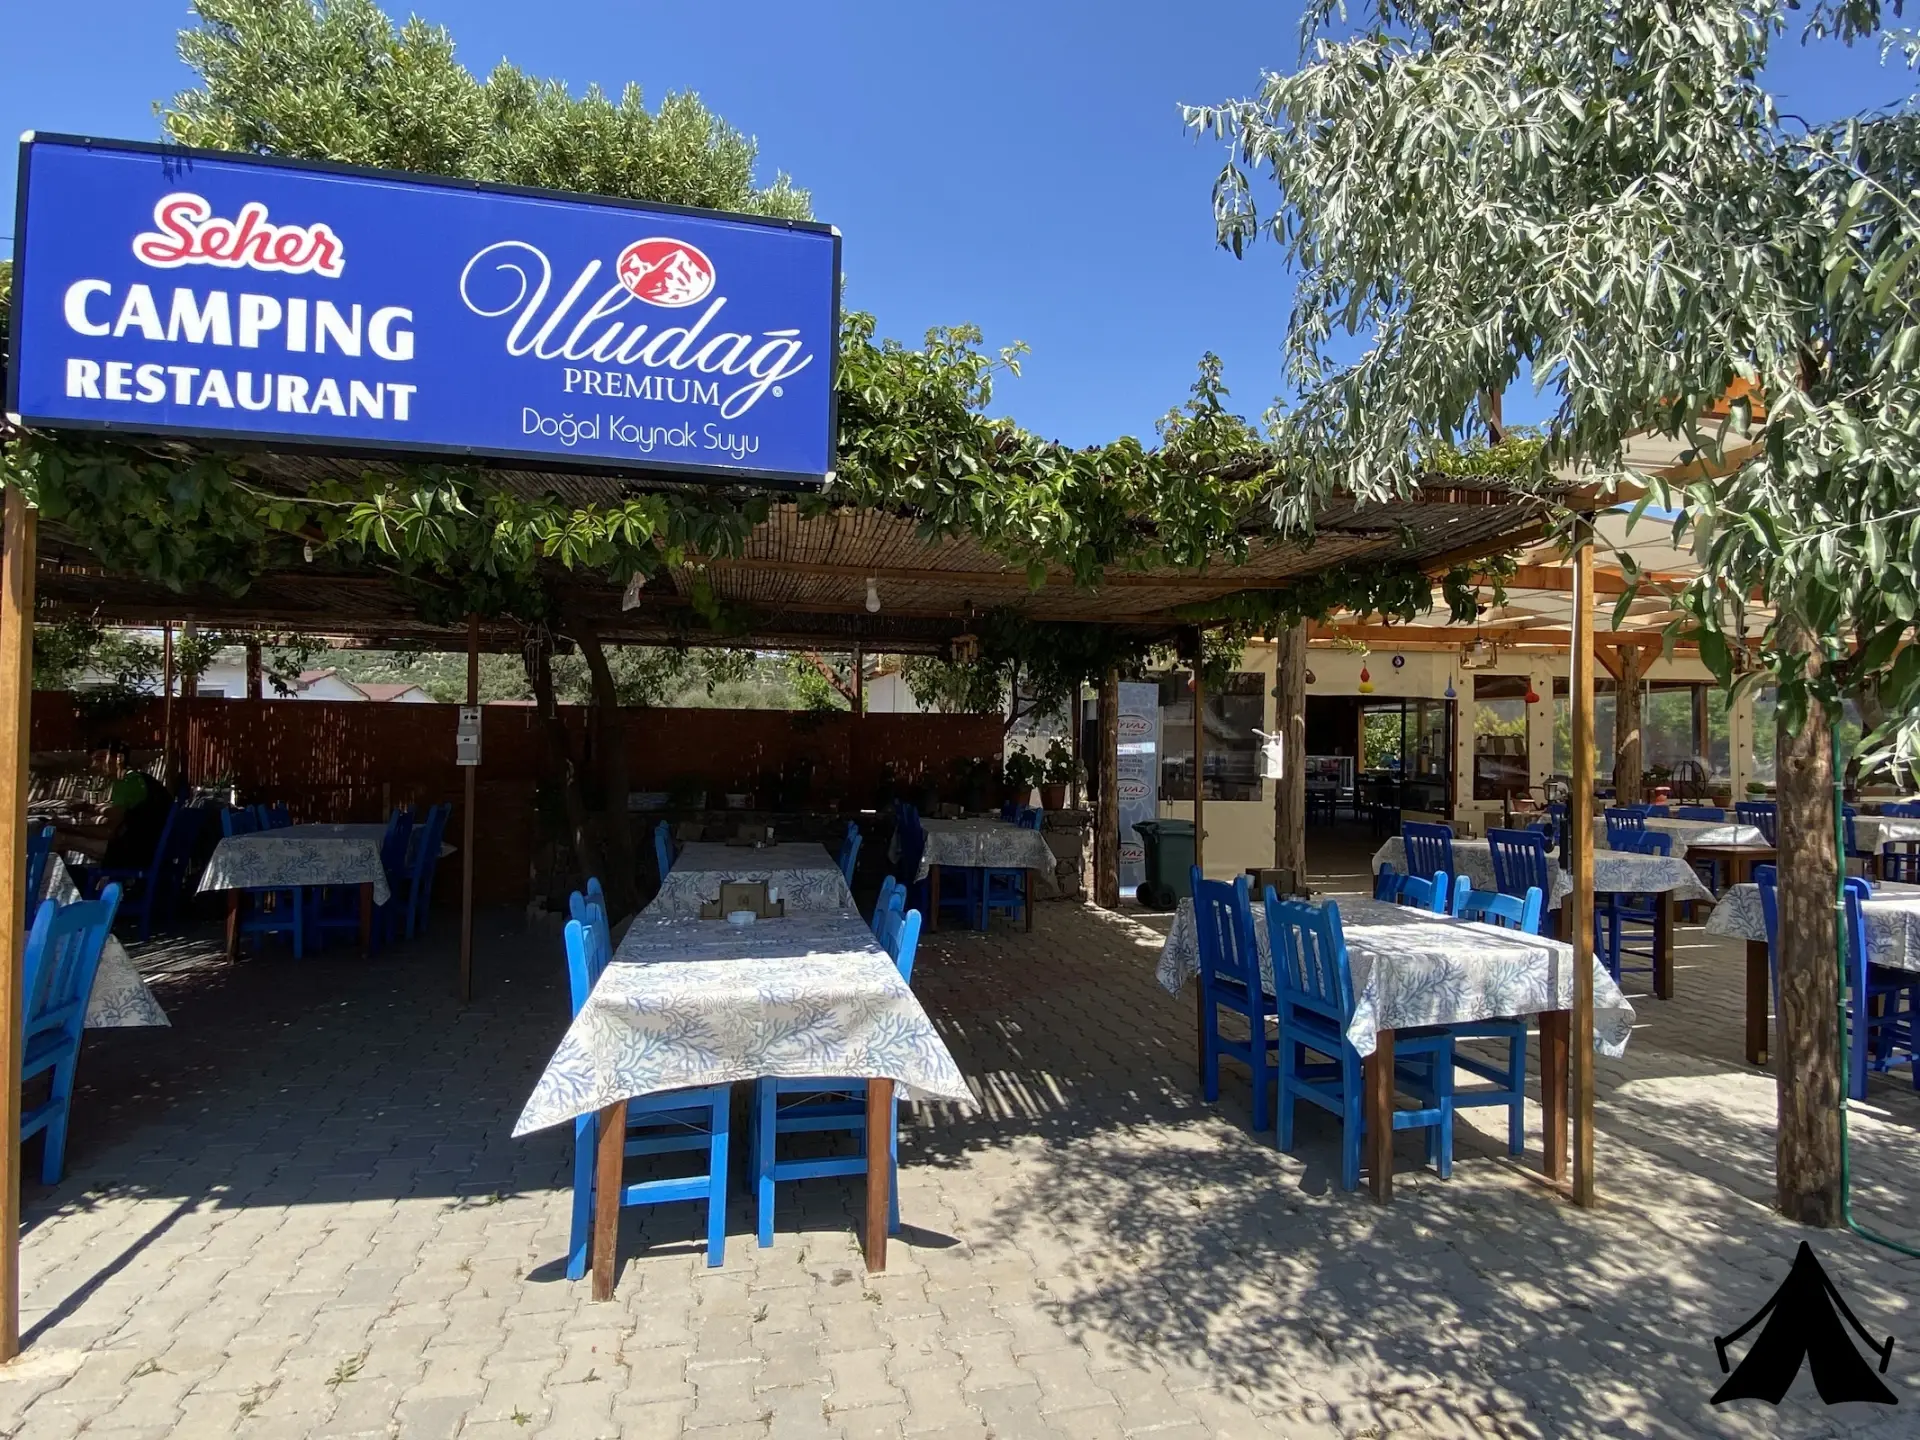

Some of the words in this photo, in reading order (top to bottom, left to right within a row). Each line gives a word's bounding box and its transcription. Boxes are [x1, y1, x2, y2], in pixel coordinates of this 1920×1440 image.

[134, 193, 345, 277] Seher
[64, 279, 415, 361] CAMPING
[460, 240, 813, 419] Uludağ
[66, 358, 417, 422] RESTAURANT
[563, 367, 720, 407] PREMIUM
[522, 406, 600, 447] Doğal
[609, 414, 697, 453] Kaynak
[703, 422, 759, 461] Suyu
